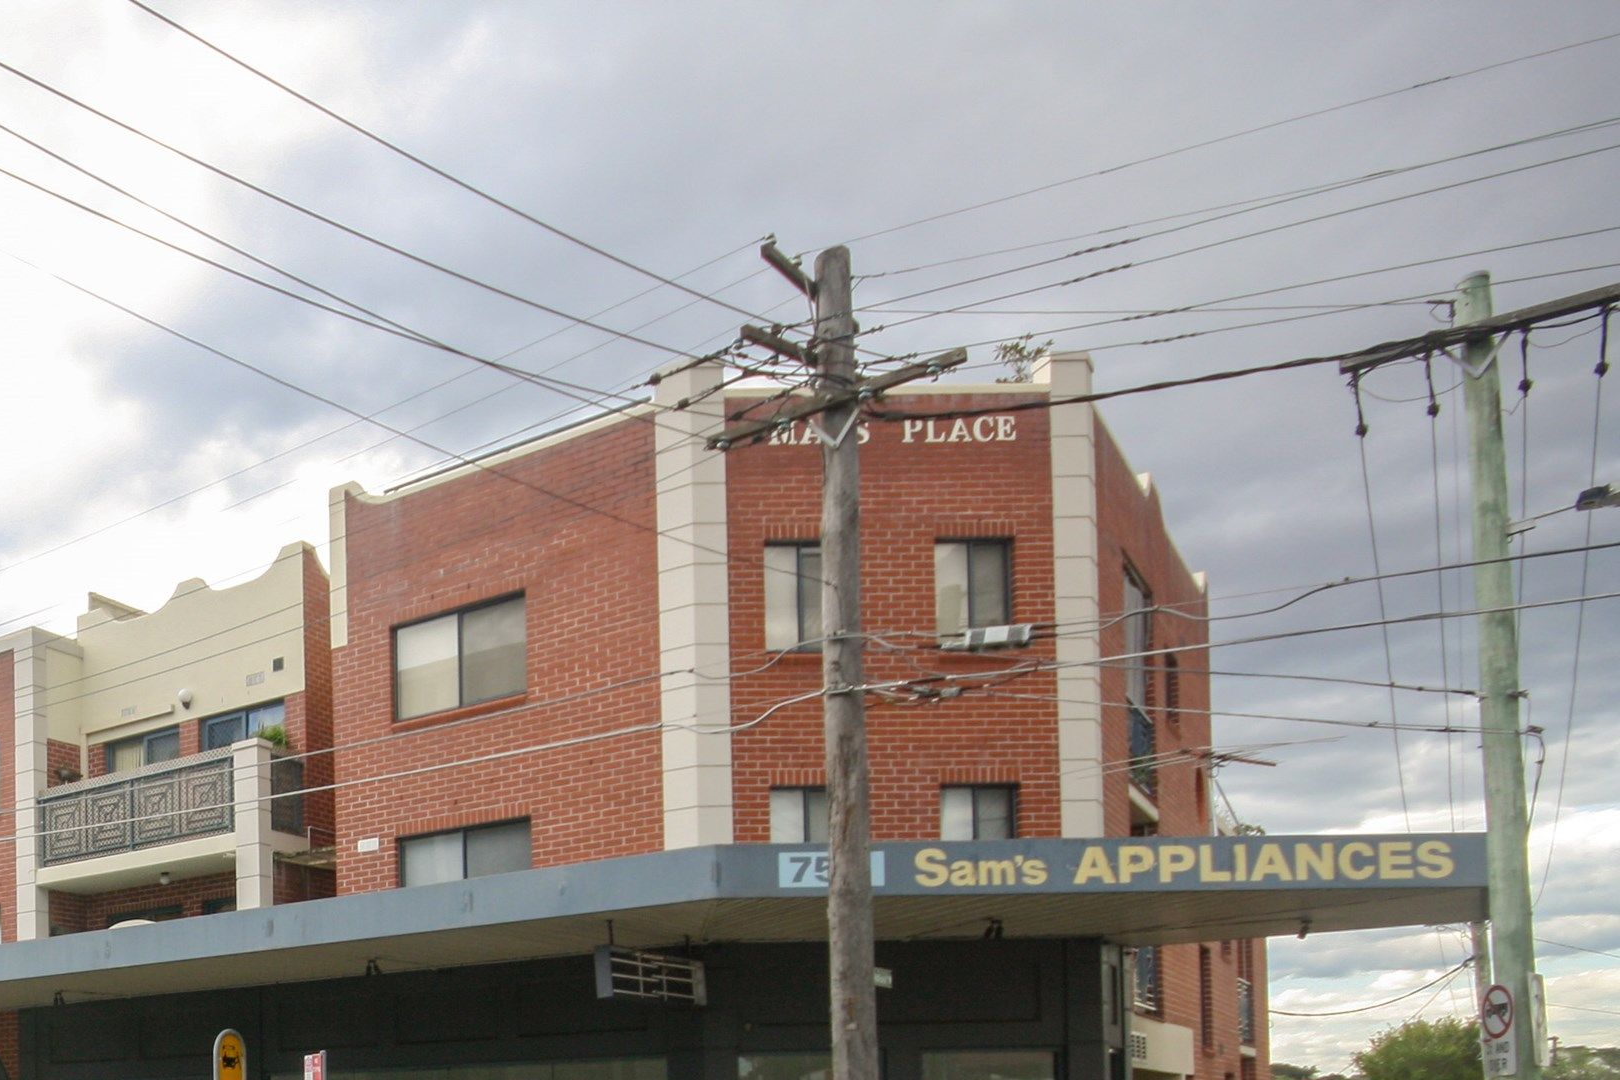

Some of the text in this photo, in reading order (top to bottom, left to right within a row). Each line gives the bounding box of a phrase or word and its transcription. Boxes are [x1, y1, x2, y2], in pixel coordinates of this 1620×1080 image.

[767, 415, 1017, 446] MAS PLACE
[914, 840, 1454, 887] Sam's APPLIANCES
